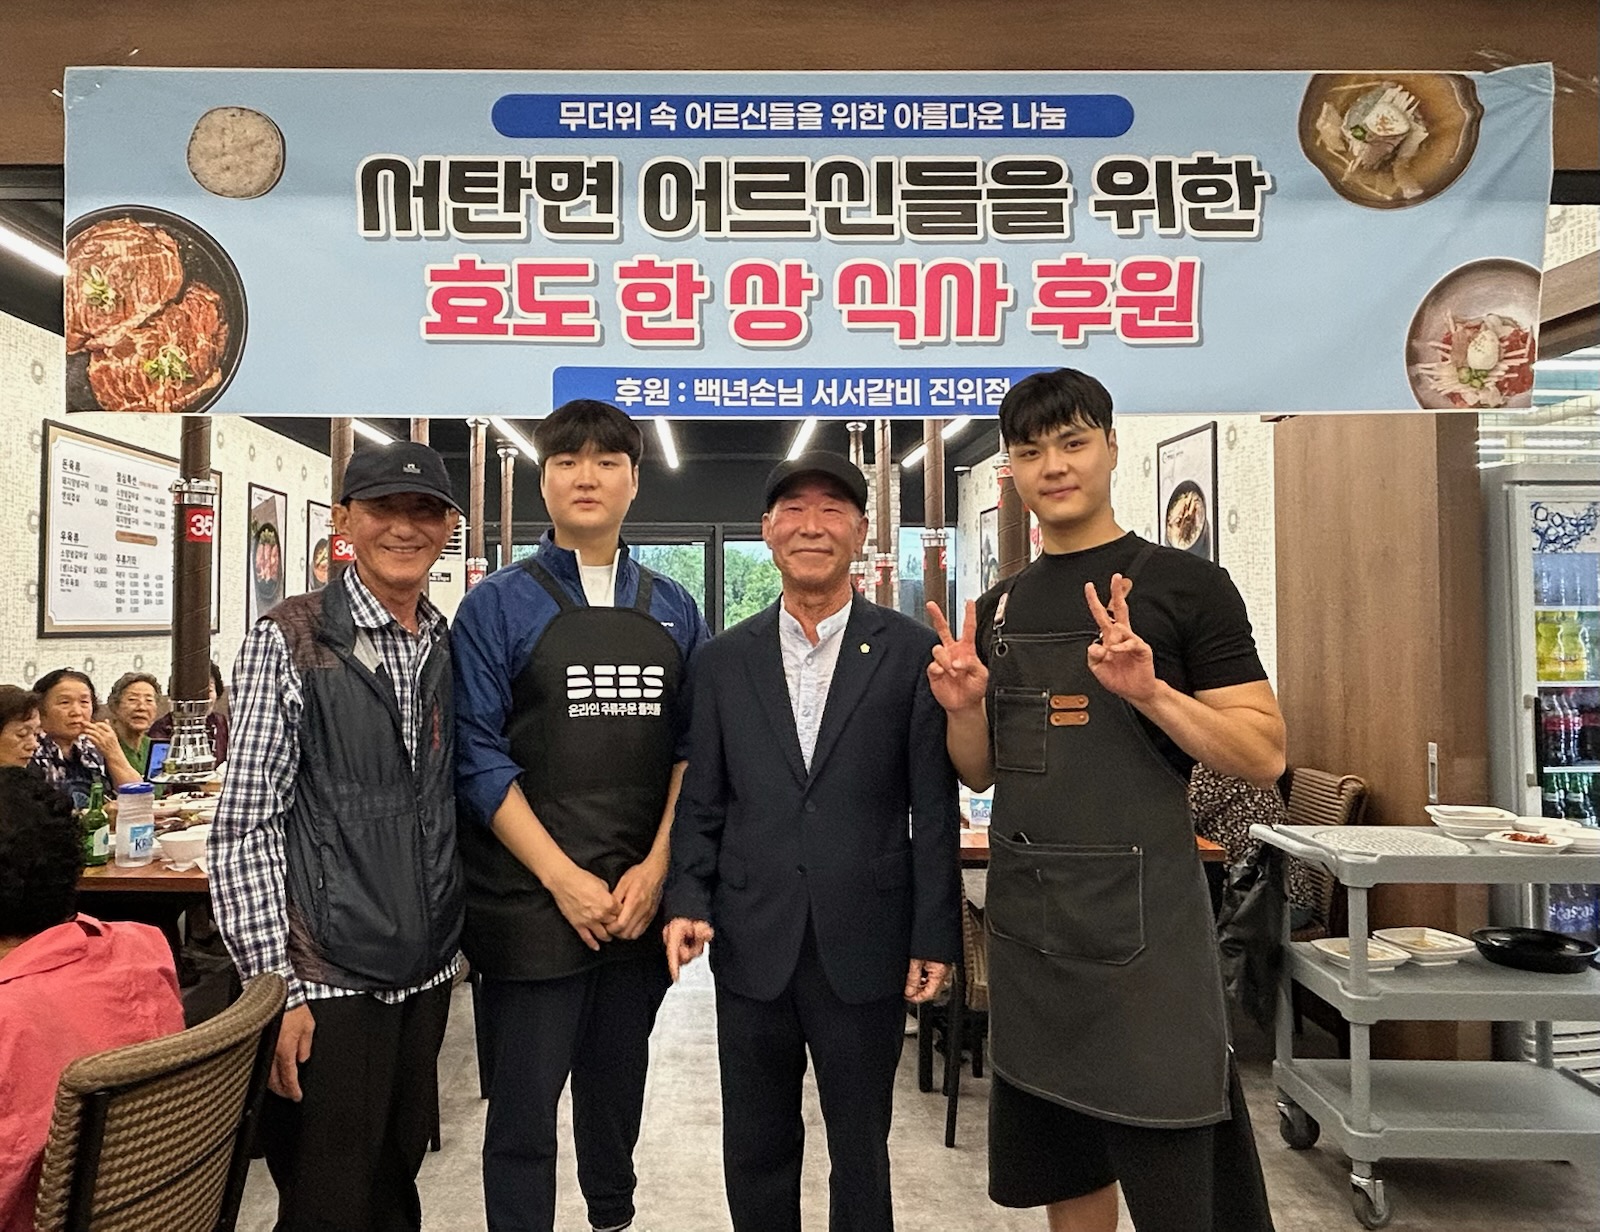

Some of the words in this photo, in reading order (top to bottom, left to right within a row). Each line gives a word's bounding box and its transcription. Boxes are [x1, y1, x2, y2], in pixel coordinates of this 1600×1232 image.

[558, 101, 642, 132] 무더위
[649, 101, 677, 132] 속
[685, 101, 823, 132] 어르신들을
[830, 101, 887, 131] 위한
[894, 101, 1005, 131] 아름다운
[1011, 101, 1067, 131] 나눔
[357, 154, 621, 240] 서탄면
[640, 155, 1071, 240] 어르신들을
[1090, 152, 1270, 238] 위한
[421, 254, 601, 342] 효도
[614, 254, 710, 346] 한
[724, 258, 817, 346] 상
[833, 257, 1014, 345] 식사
[1027, 253, 1201, 345] 후원
[614, 377, 671, 407] 후원
[693, 377, 804, 407] 백년손님
[812, 377, 921, 407] 서서갈비
[928, 377, 1011, 407] 진위점
[190, 513, 214, 537] 35
[567, 702, 600, 718] 온라인
[600, 702, 638, 716] 주류주문
